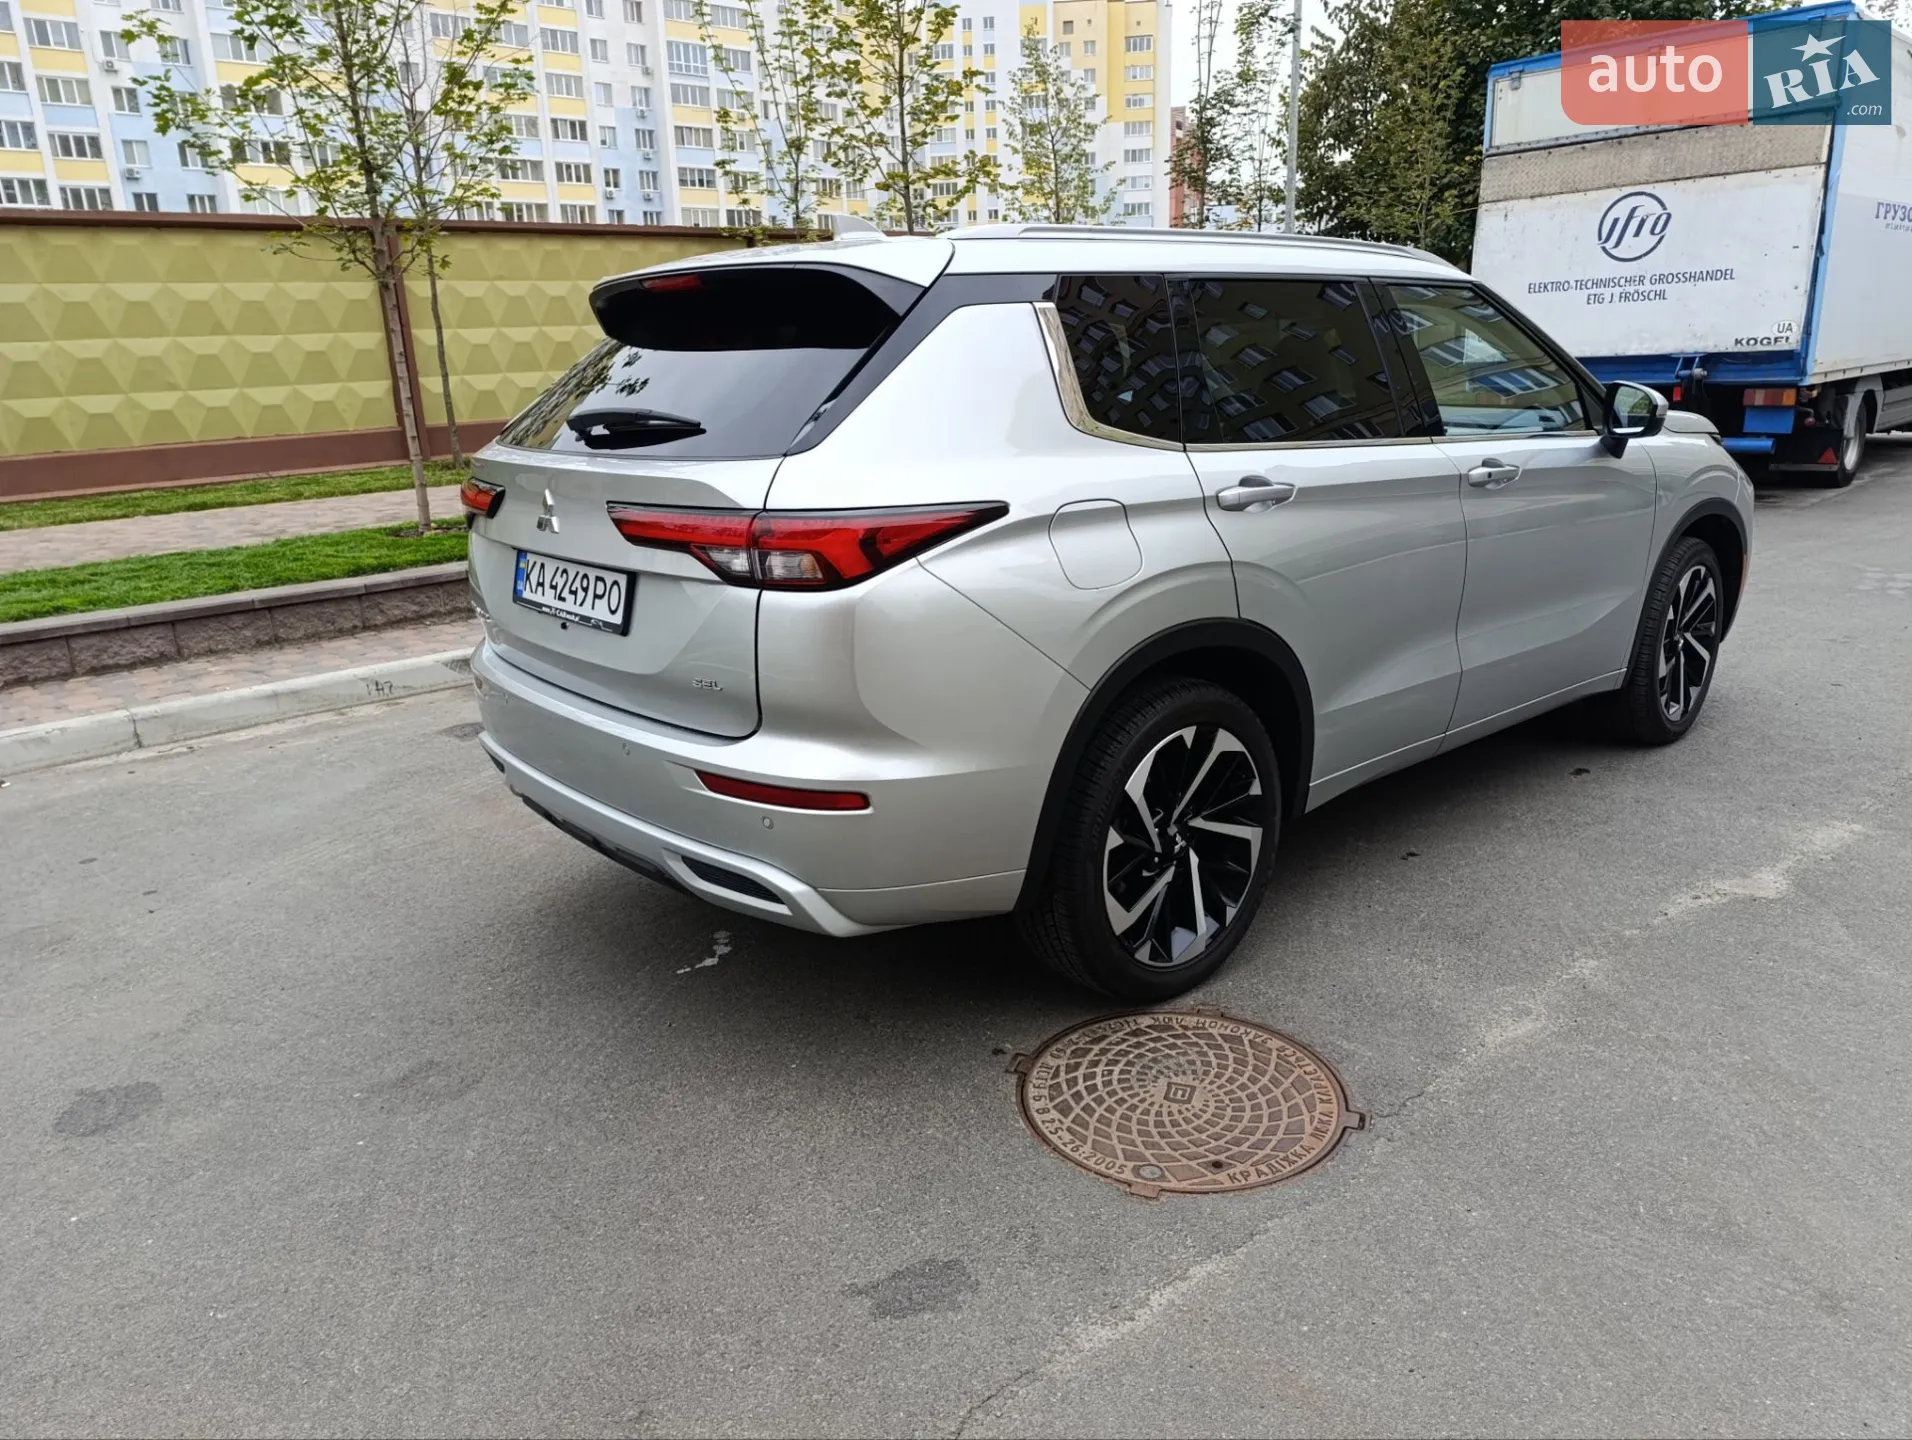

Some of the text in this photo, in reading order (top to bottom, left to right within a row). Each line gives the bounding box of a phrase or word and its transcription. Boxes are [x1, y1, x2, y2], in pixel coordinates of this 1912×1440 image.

[1649, 268, 1736, 286] GROSSHANDEL
[1586, 293, 1605, 305] ETG
[1619, 289, 1668, 303] FRÖSCHL
[1777, 322, 1793, 334] UA
[524, 558, 546, 597] KA
[549, 565, 590, 608] 4249
[591, 575, 622, 616] PO
[691, 677, 723, 692] SEL
[1195, 1016, 1274, 1045] ЗАКОНОМ
[1226, 1143, 1317, 1184] КРАДІЖКА
